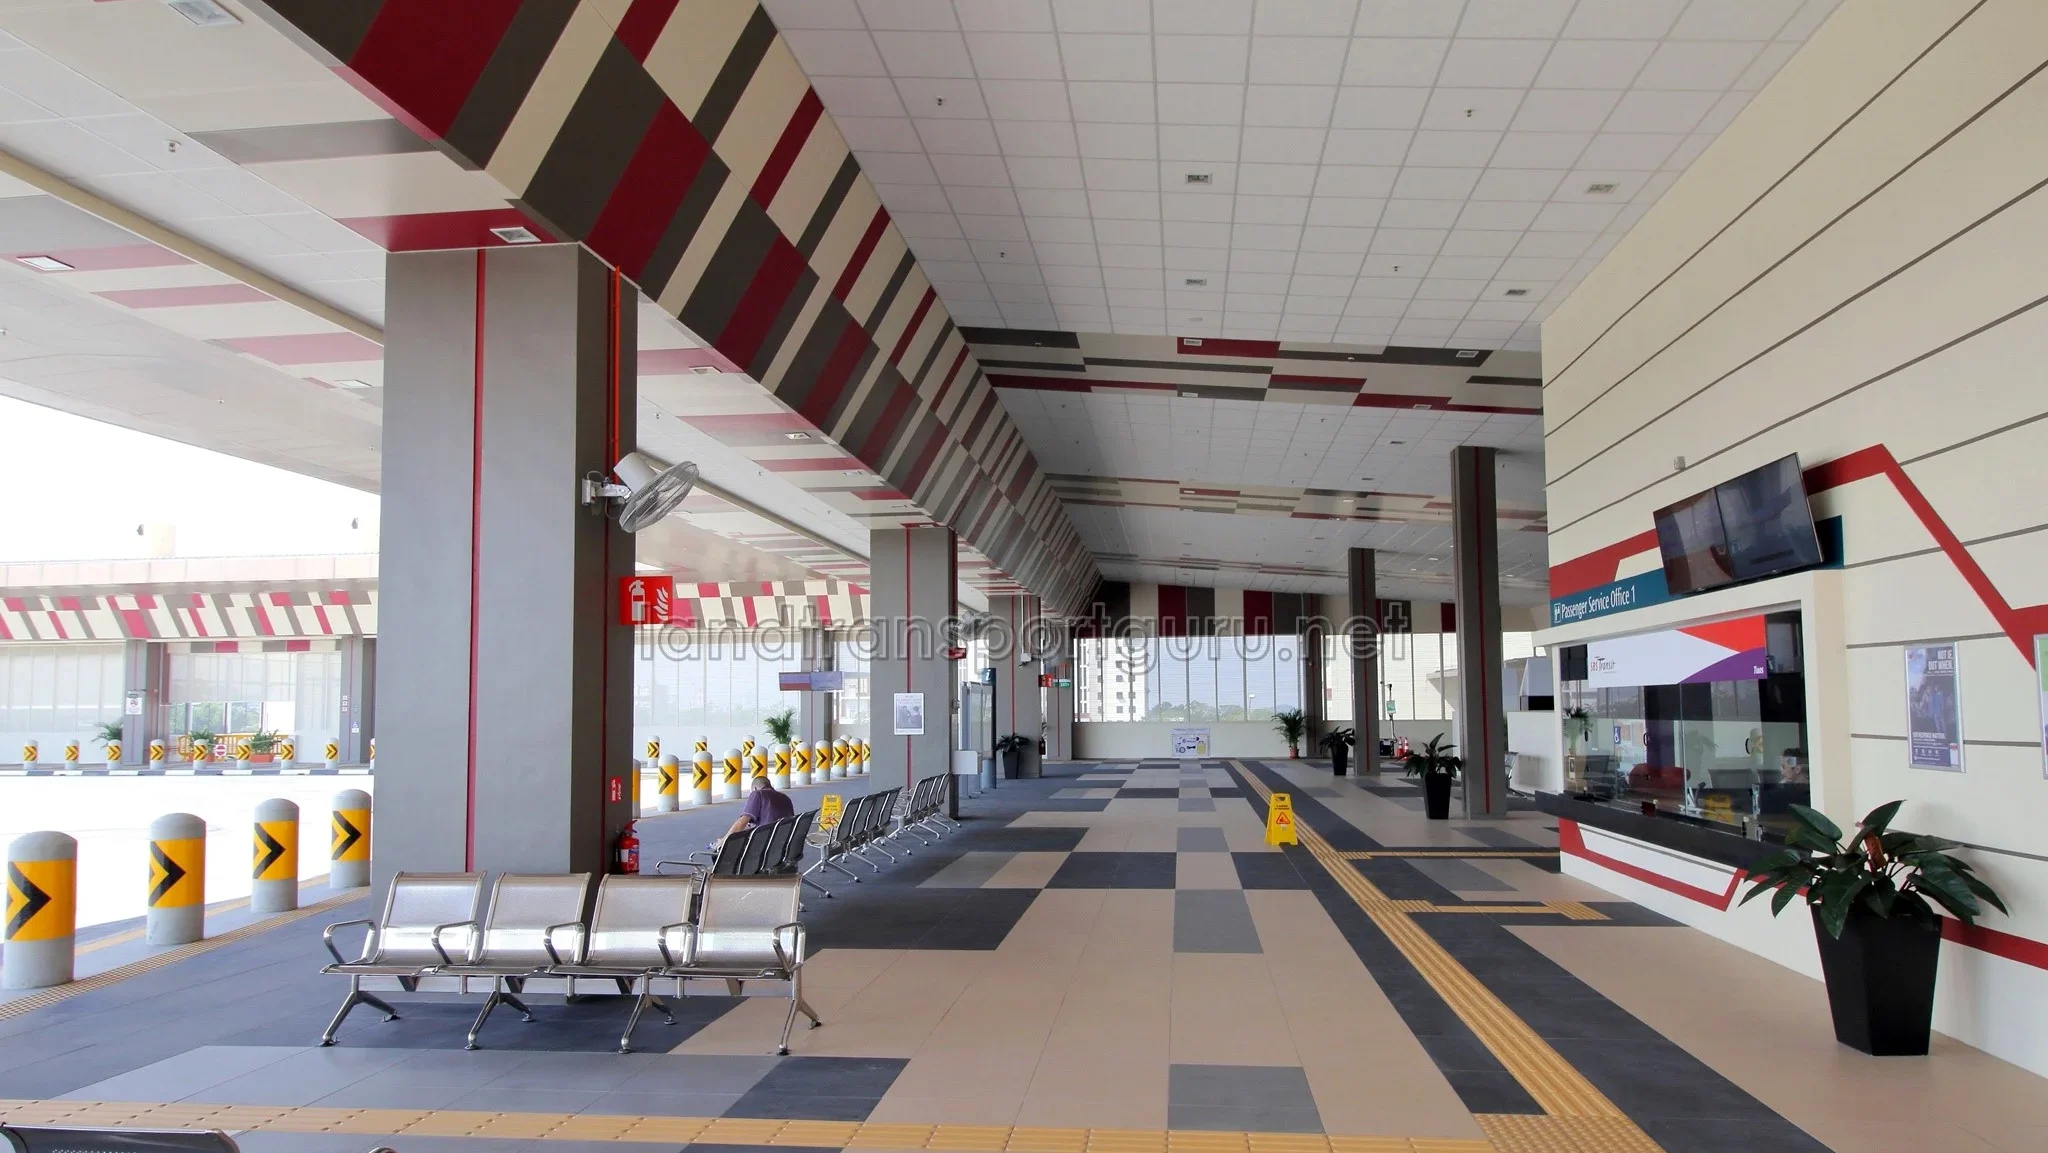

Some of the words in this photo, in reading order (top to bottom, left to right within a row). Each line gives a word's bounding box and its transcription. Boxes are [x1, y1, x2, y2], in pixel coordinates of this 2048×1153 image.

[1561, 601, 1588, 619] Passenger
[1588, 592, 1610, 613] Service
[1610, 586, 1630, 608] Office
[1630, 584, 1636, 603] 1
